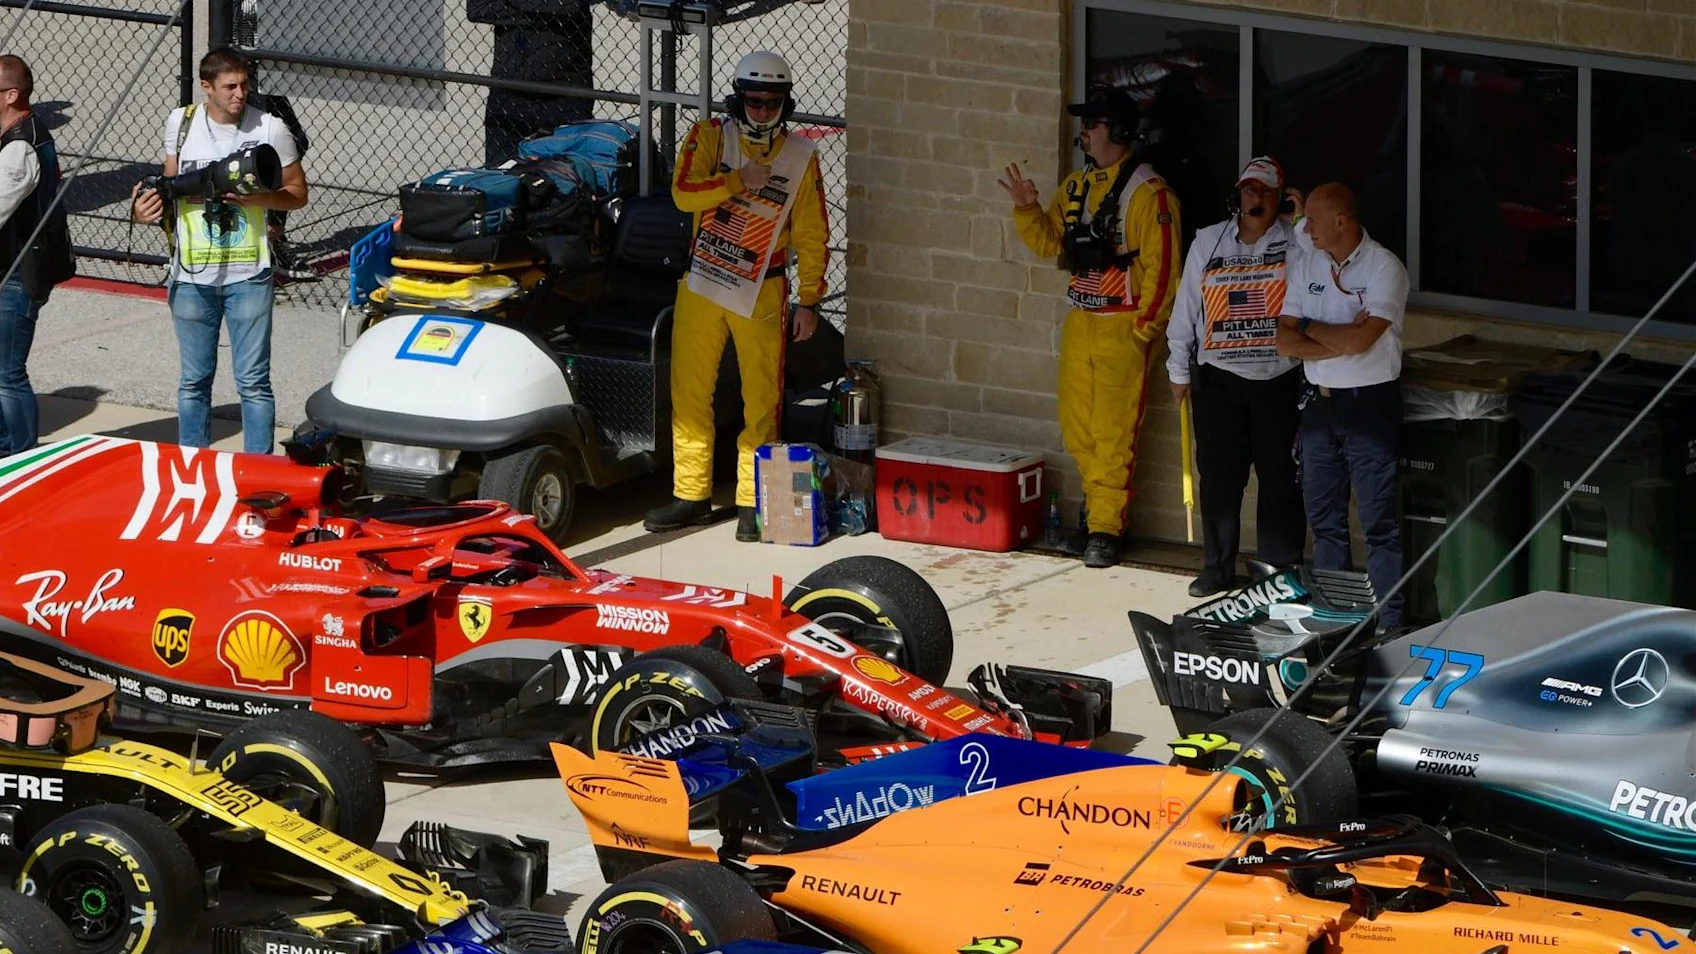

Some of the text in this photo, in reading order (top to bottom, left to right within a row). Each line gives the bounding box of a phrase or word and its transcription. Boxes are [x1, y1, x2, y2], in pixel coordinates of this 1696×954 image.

[715, 235, 745, 258] LANE
[1084, 294, 1108, 306] LANE
[1222, 318, 1276, 331] PIT LANE
[1226, 331, 1242, 340] ALL
[892, 477, 988, 525] OPS
[278, 552, 343, 573] HUBLOT
[596, 603, 669, 624] MISSION
[595, 616, 669, 635] WINNOW
[155, 627, 189, 659] ups
[314, 635, 357, 649] SINGHA
[804, 630, 844, 654] 5
[1173, 650, 1260, 685] EPSON
[1399, 645, 1485, 709] 77
[120, 676, 141, 690] NGK
[325, 676, 393, 701] Lenovo
[1562, 679, 1603, 699] AMG
[171, 694, 201, 707] SKF
[842, 680, 923, 724] KASPERSKY
[1420, 747, 1481, 763] PETRONAS
[959, 742, 997, 797] 2
[1415, 760, 1478, 779] PRIMAX
[581, 782, 669, 805] NTT Communications
[1017, 794, 1152, 830] CHANDON
[1339, 822, 1366, 833] FxPro
[84, 832, 152, 893] ZERO
[1237, 855, 1264, 866] FxPro
[801, 874, 902, 907] RENAULT
[1050, 874, 1146, 898] PETROBRAS
[1453, 926, 1560, 948] RICHARD MILLE
[1631, 927, 1680, 950] 2
